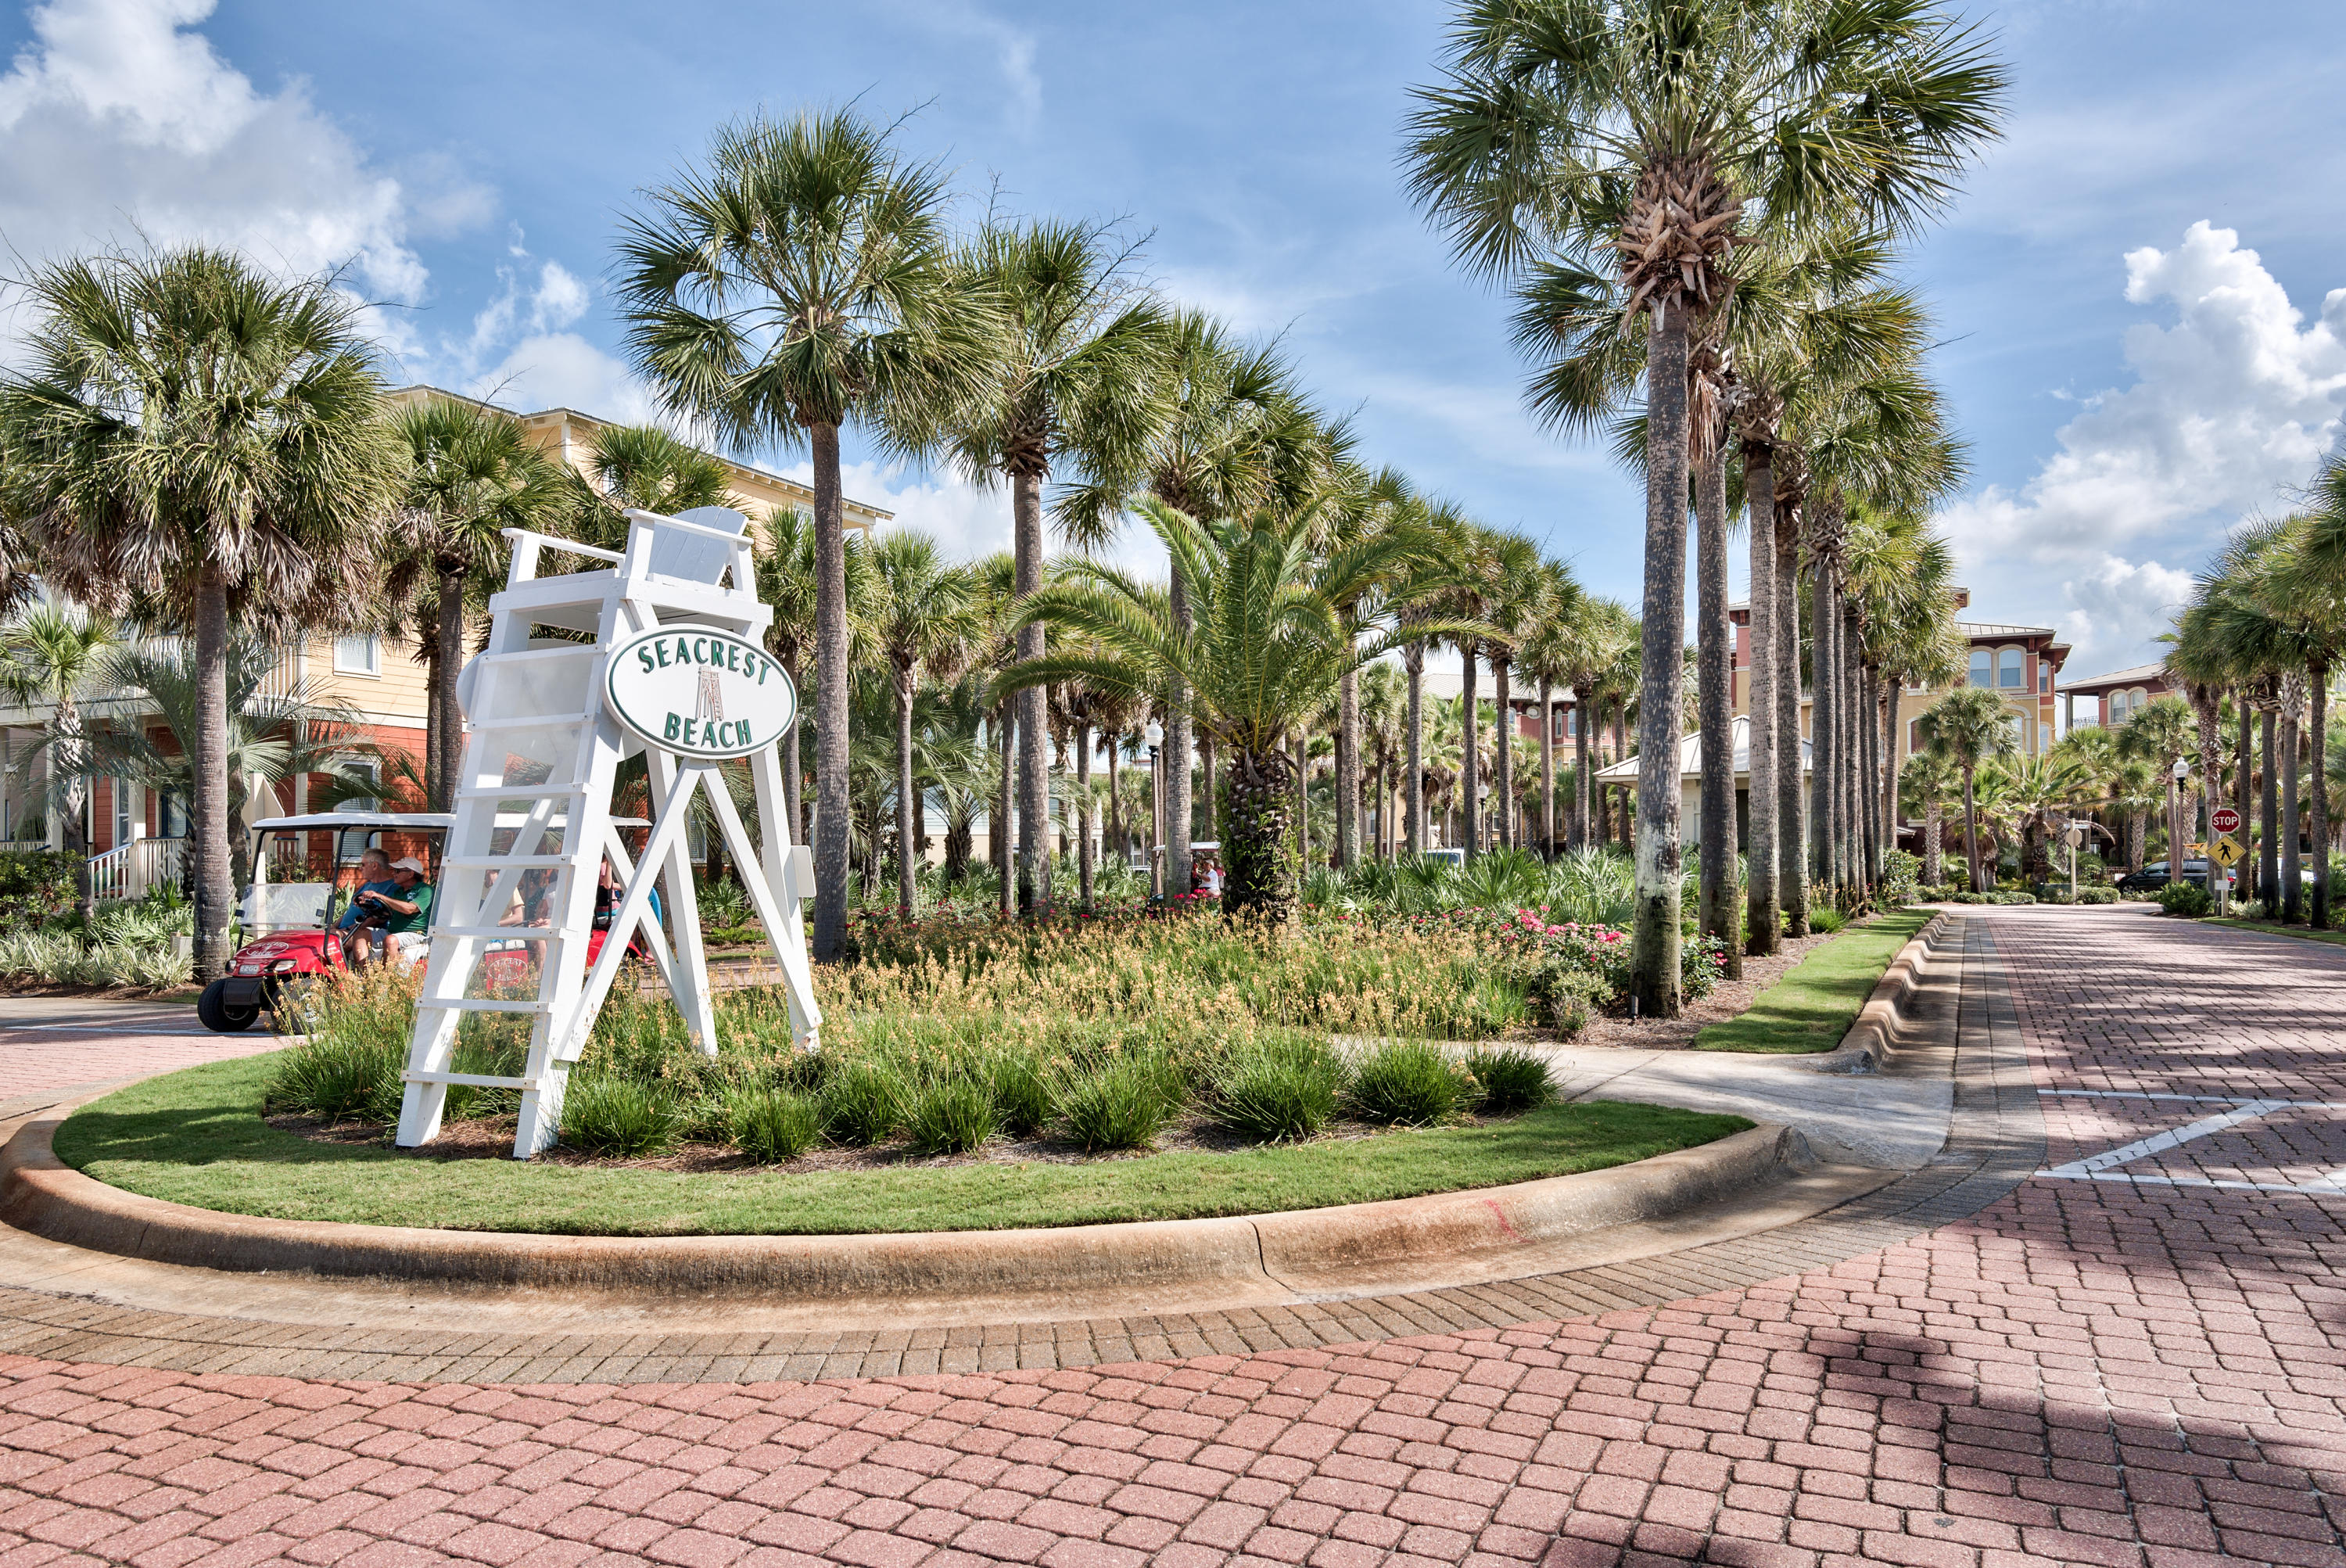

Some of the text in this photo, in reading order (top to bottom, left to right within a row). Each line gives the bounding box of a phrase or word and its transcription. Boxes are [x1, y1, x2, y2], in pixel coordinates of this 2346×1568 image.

[638, 637, 770, 685] SEACREST
[664, 712, 752, 748] BEACH
[2213, 816, 2238, 826] STOP
